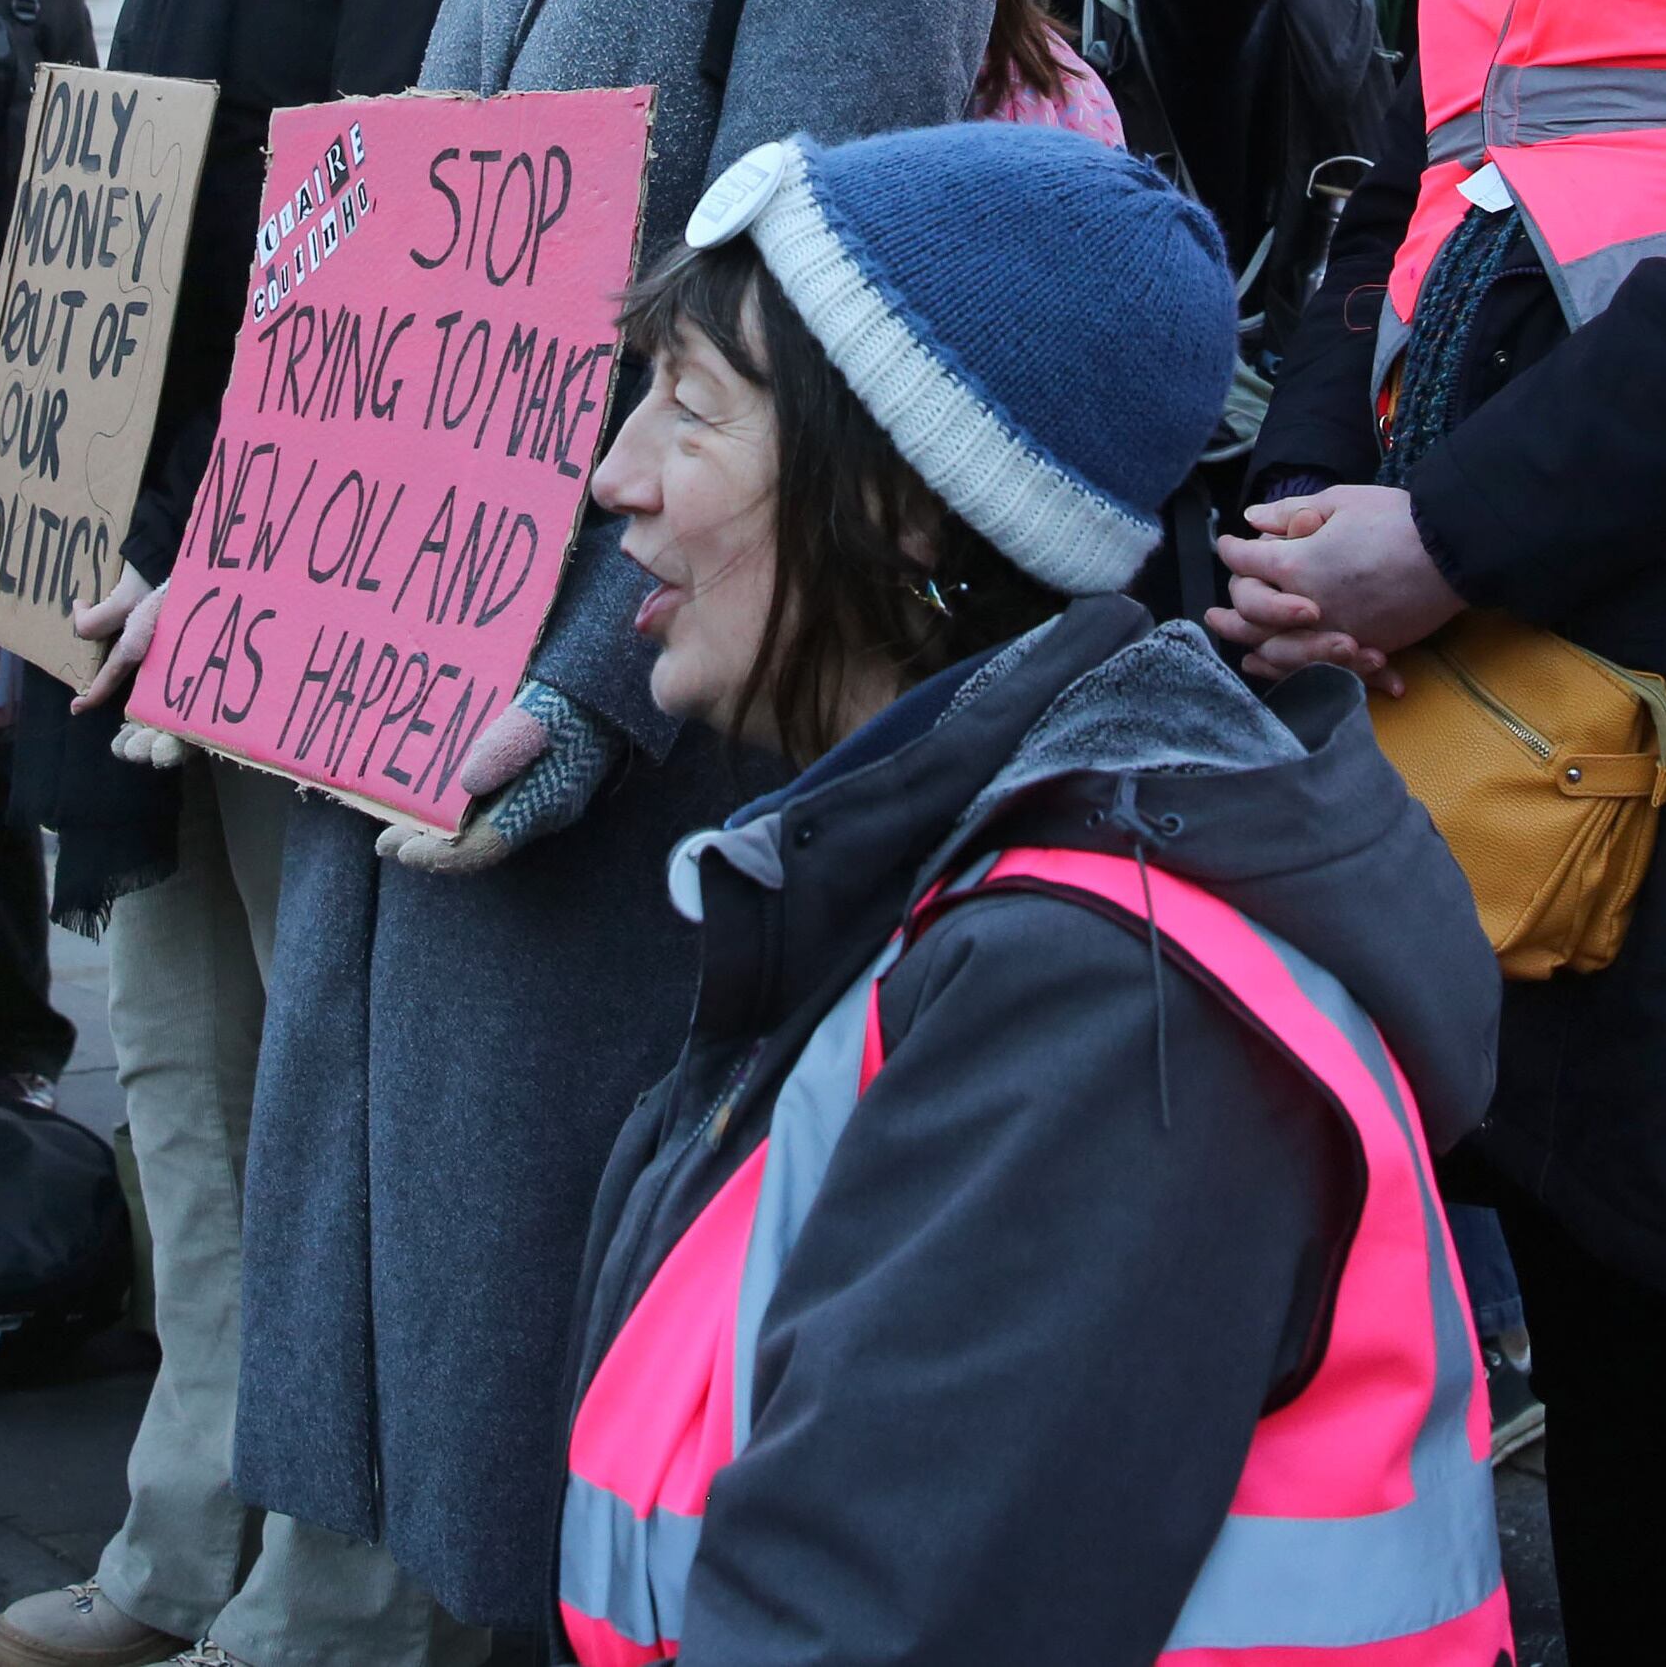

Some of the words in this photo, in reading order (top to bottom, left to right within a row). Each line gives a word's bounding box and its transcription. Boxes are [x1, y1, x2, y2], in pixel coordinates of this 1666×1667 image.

[41, 80, 138, 177] OILY
[9, 179, 162, 283] MONEY
[410, 146, 572, 287] STOP
[1, 279, 87, 374] OUT
[89, 301, 148, 380] OF
[258, 301, 416, 423] TRYING
[424, 310, 491, 431] TO
[474, 322, 614, 480] MAKE
[186, 437, 317, 574] NEW
[307, 468, 407, 592] OIL
[391, 484, 538, 629] AND
[163, 585, 277, 725] GAS
[276, 624, 498, 805] HAPPEN
